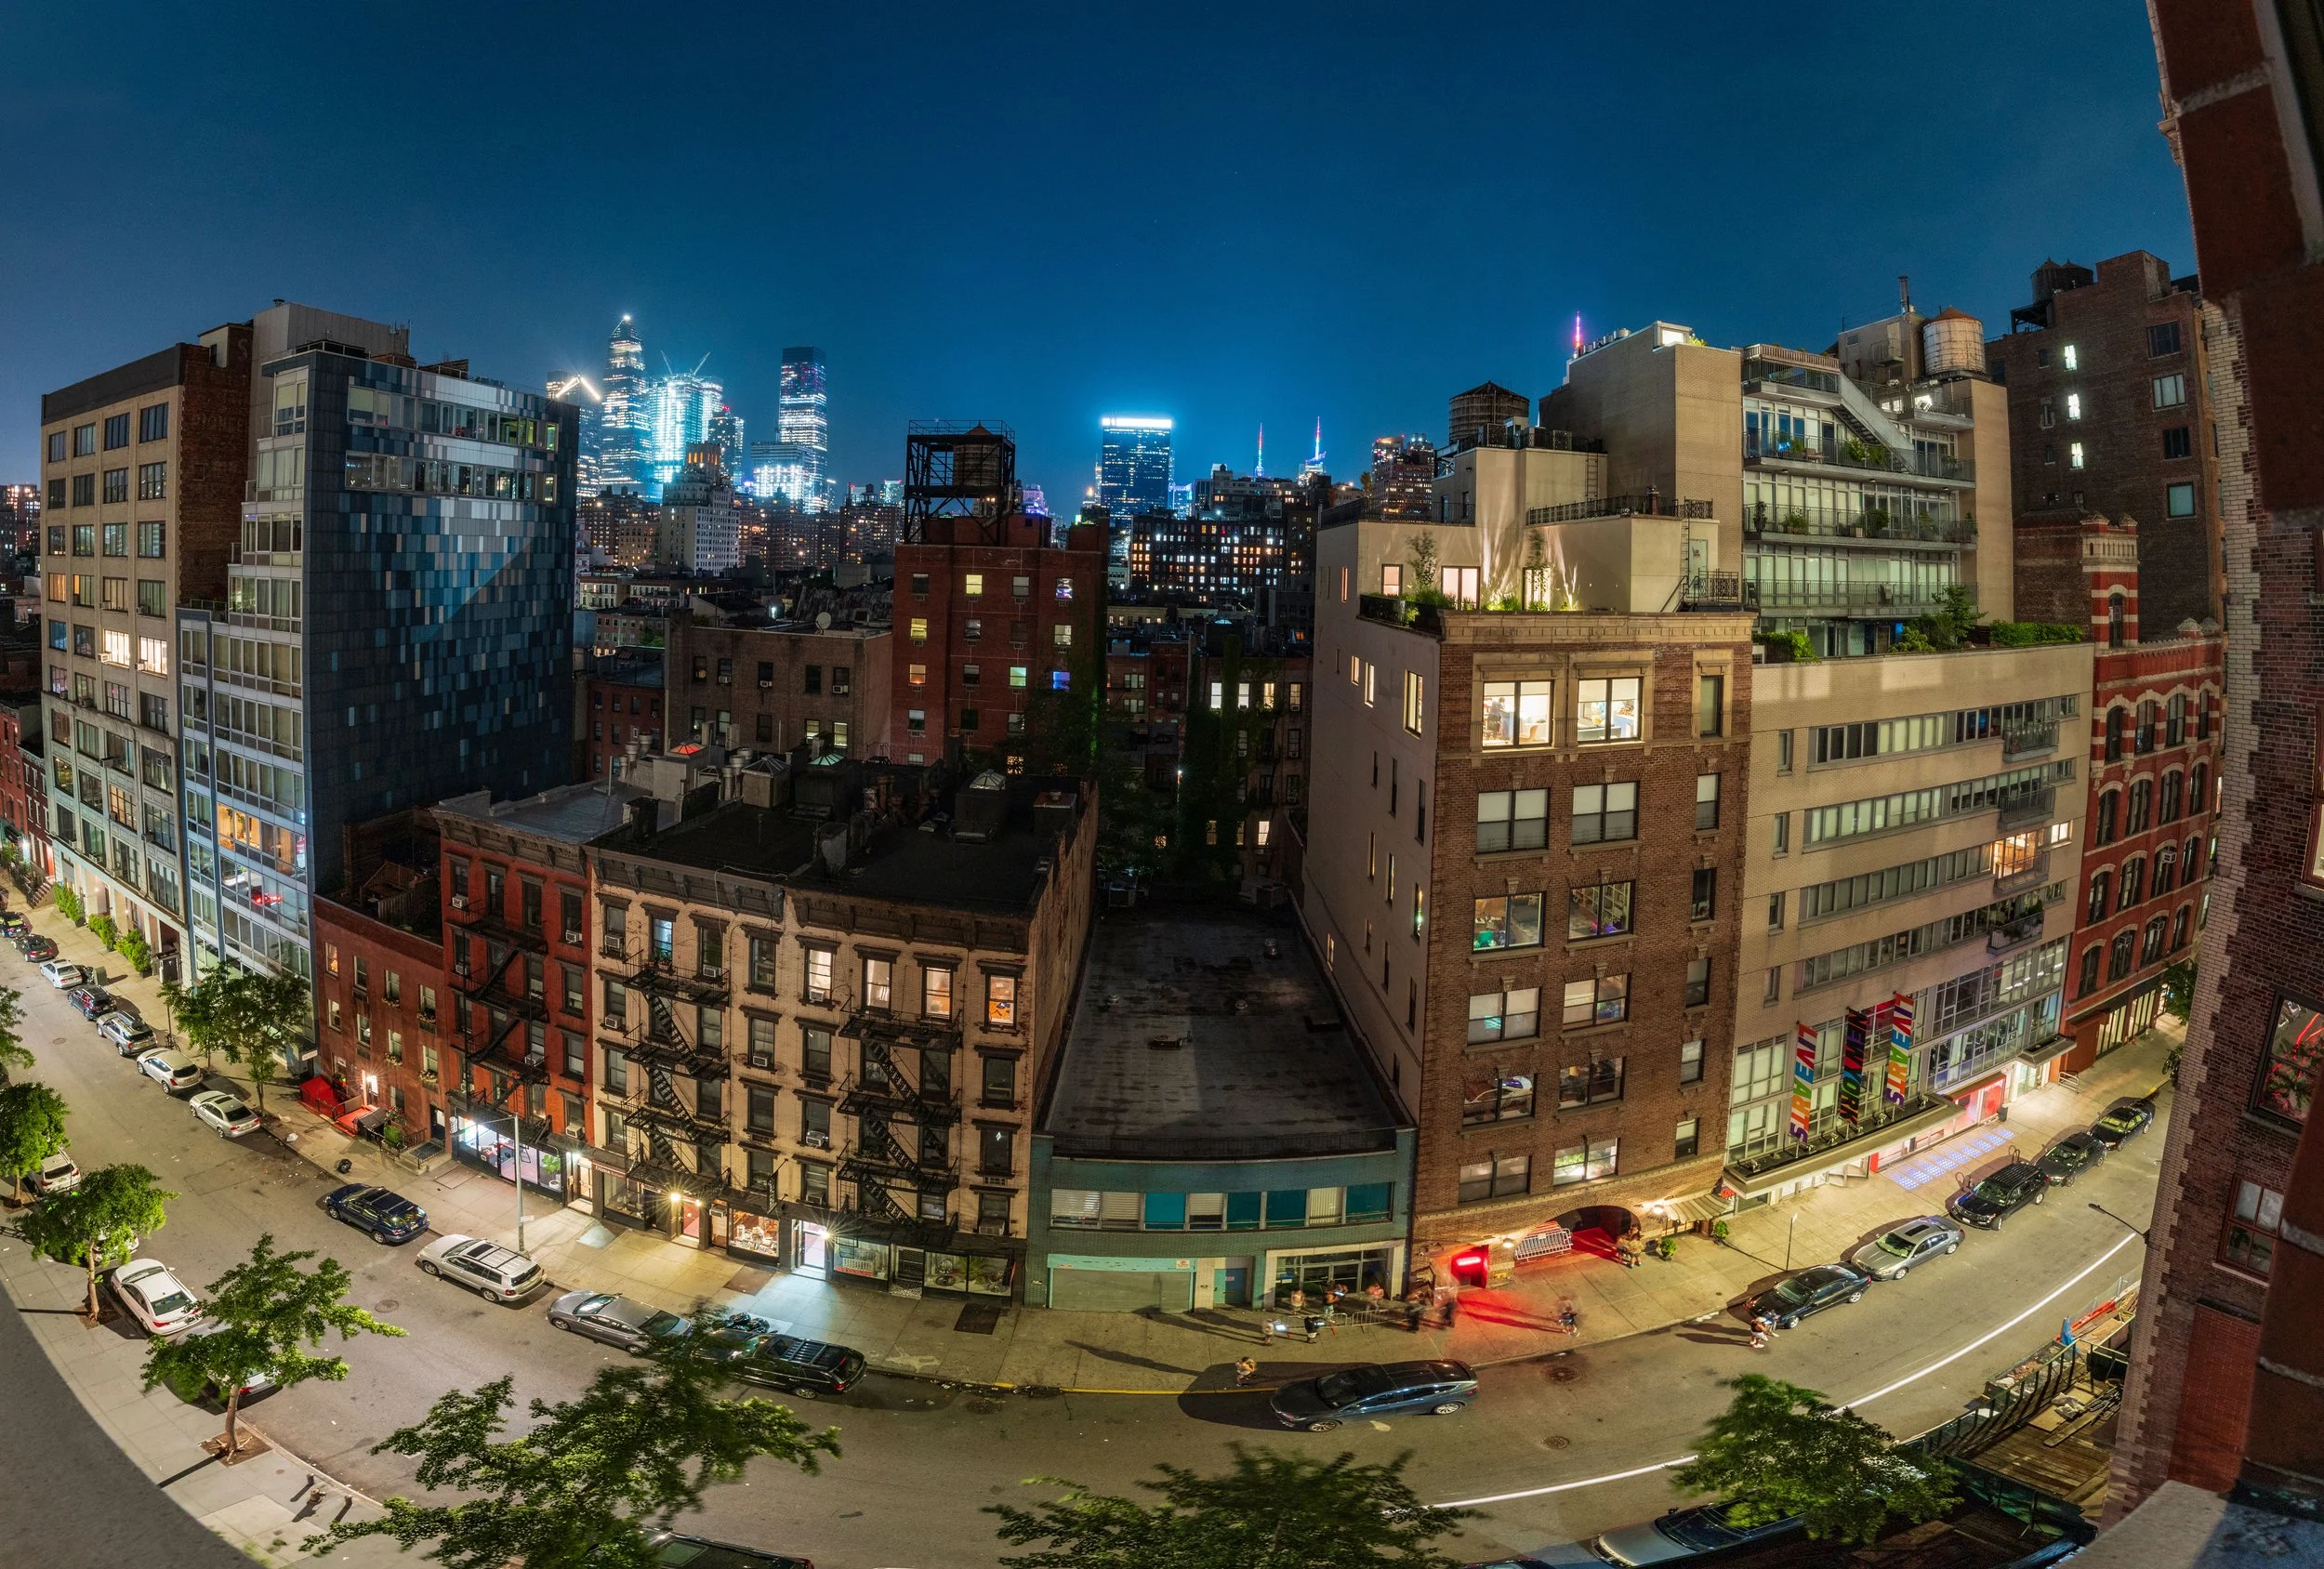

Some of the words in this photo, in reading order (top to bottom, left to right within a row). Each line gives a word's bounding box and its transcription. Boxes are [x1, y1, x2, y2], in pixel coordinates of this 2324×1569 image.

[1844, 1008, 1868, 1071] NEW
[1891, 992, 1915, 1050] LIVE
[1794, 1023, 1818, 1085] LIVE
[1884, 1046, 1908, 1111] ARTS
[1789, 1078, 1813, 1145] ARTS
[1839, 1071, 1862, 1126] YORK
